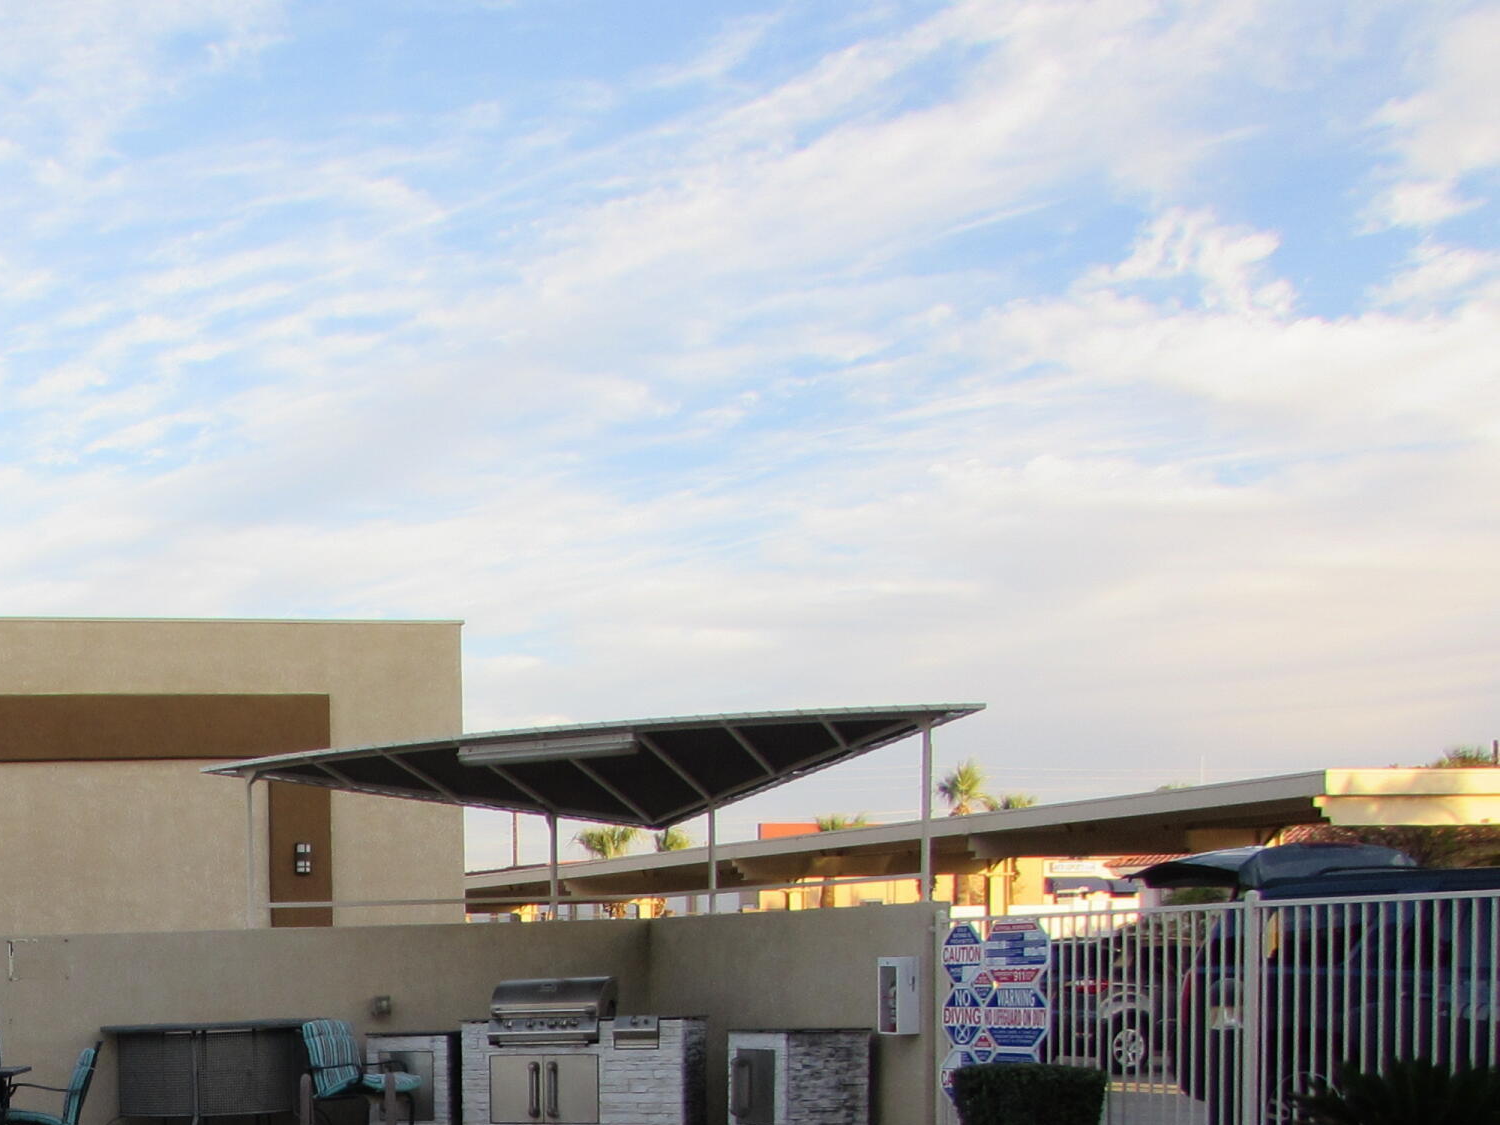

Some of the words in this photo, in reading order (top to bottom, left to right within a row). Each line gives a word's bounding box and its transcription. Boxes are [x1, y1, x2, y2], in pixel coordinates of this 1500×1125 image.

[943, 947, 981, 962] CAUTION
[1013, 970, 1025, 982] 911
[955, 990, 970, 1006] NO
[998, 989, 1035, 1006] WARNING
[943, 1008, 981, 1024] DIVING
